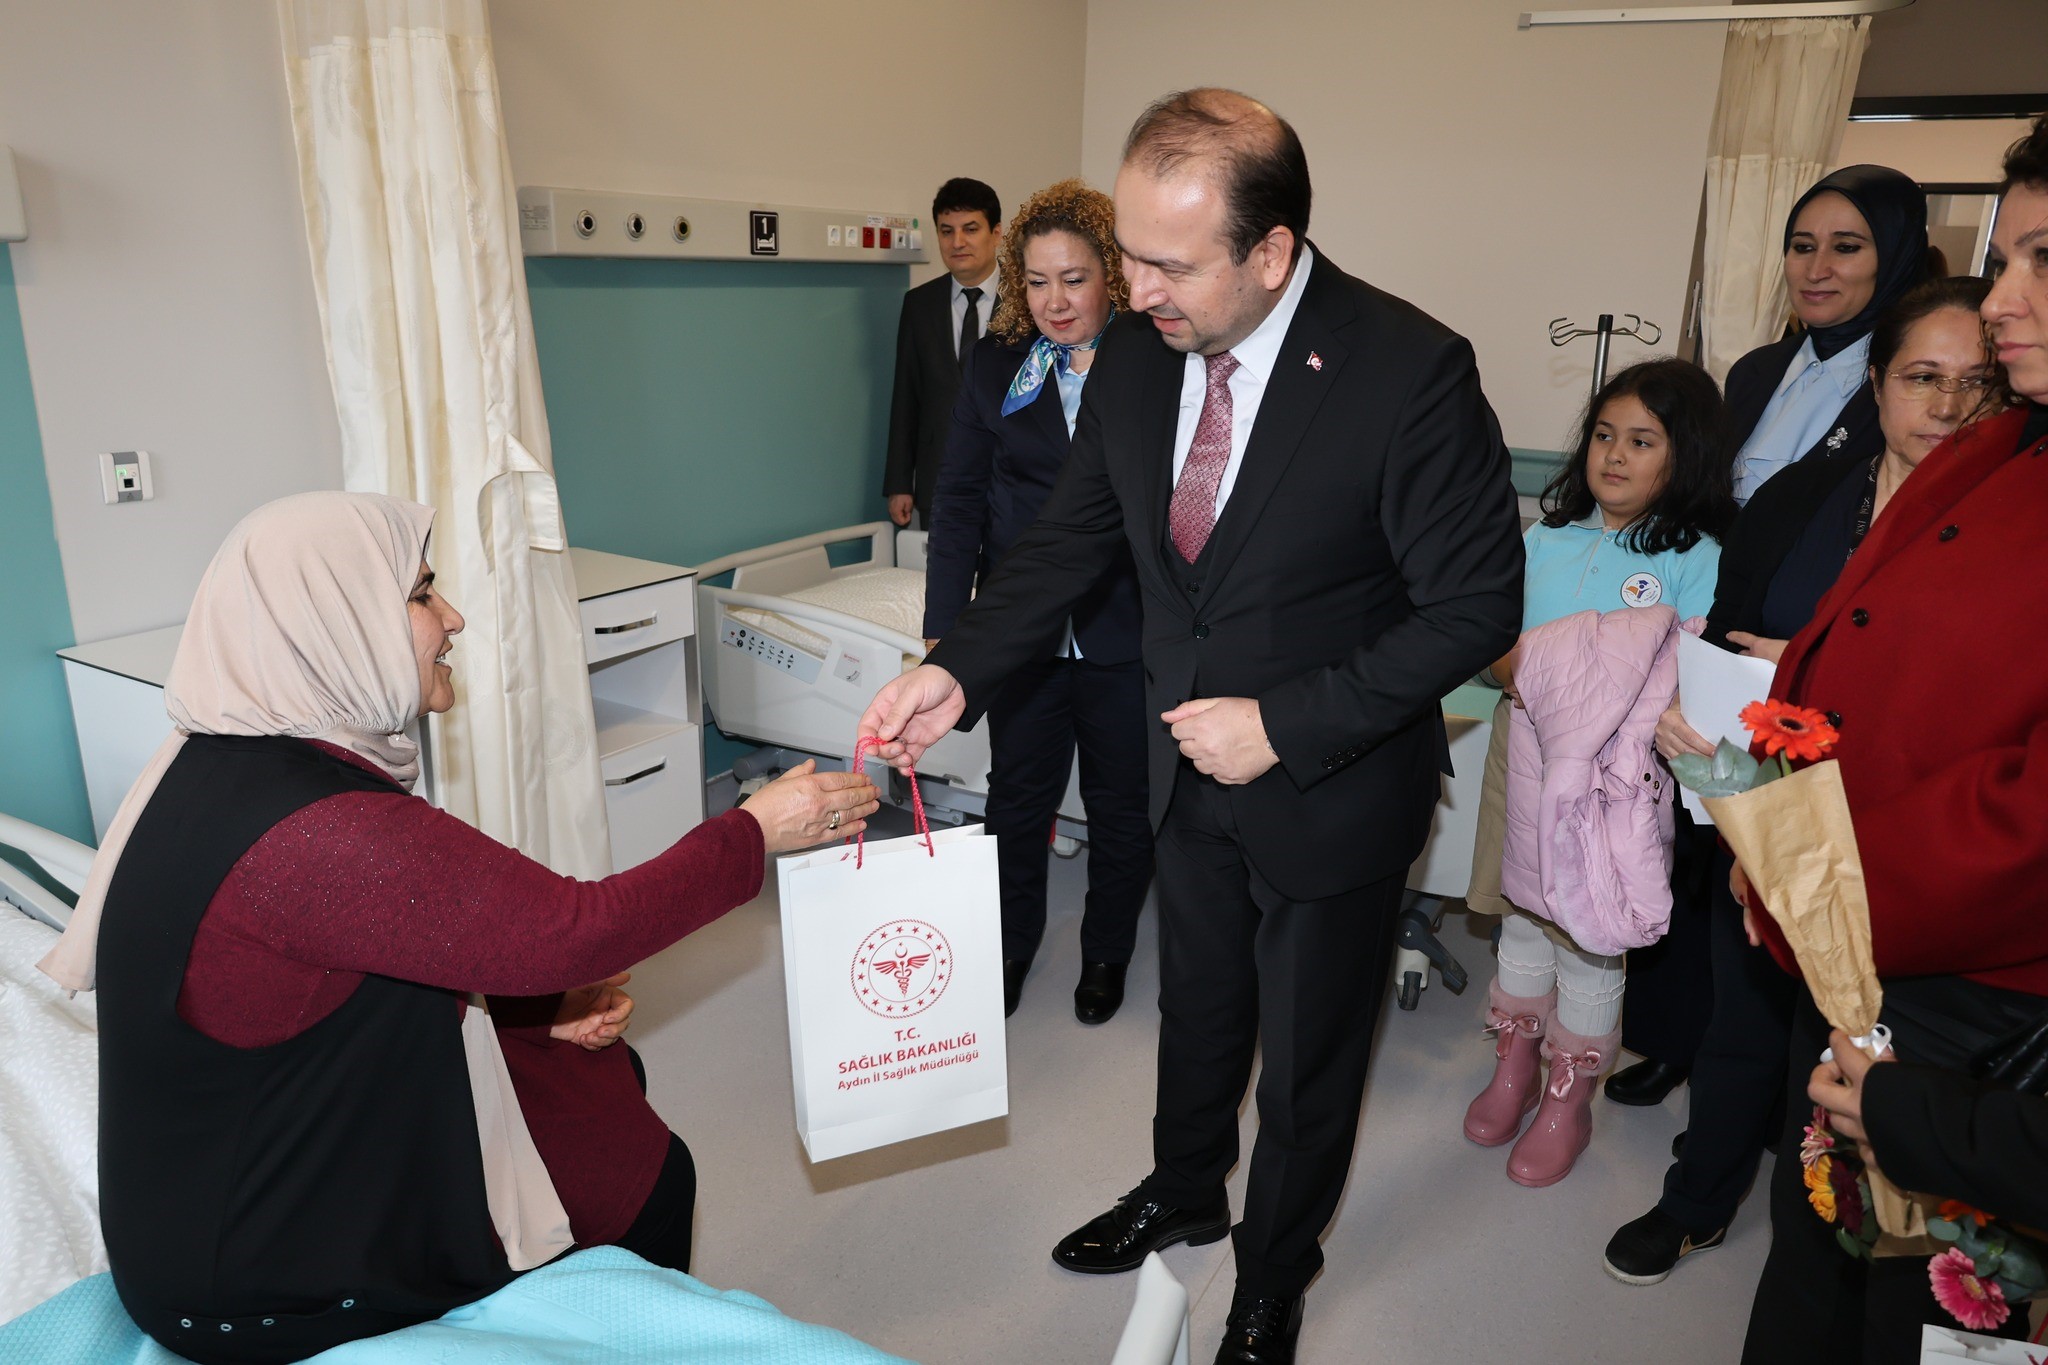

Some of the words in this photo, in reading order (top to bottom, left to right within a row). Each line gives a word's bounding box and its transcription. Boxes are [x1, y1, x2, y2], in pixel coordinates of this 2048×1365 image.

[761, 217, 768, 235] 1
[894, 1027, 921, 1042] T.C.
[838, 1052, 893, 1074] SAĞLIK
[896, 1032, 977, 1062] BAKANLIĞI
[838, 1077, 870, 1090] Aydın
[883, 1065, 917, 1080] Sağlık
[920, 1050, 979, 1072] Müdürlüğü
